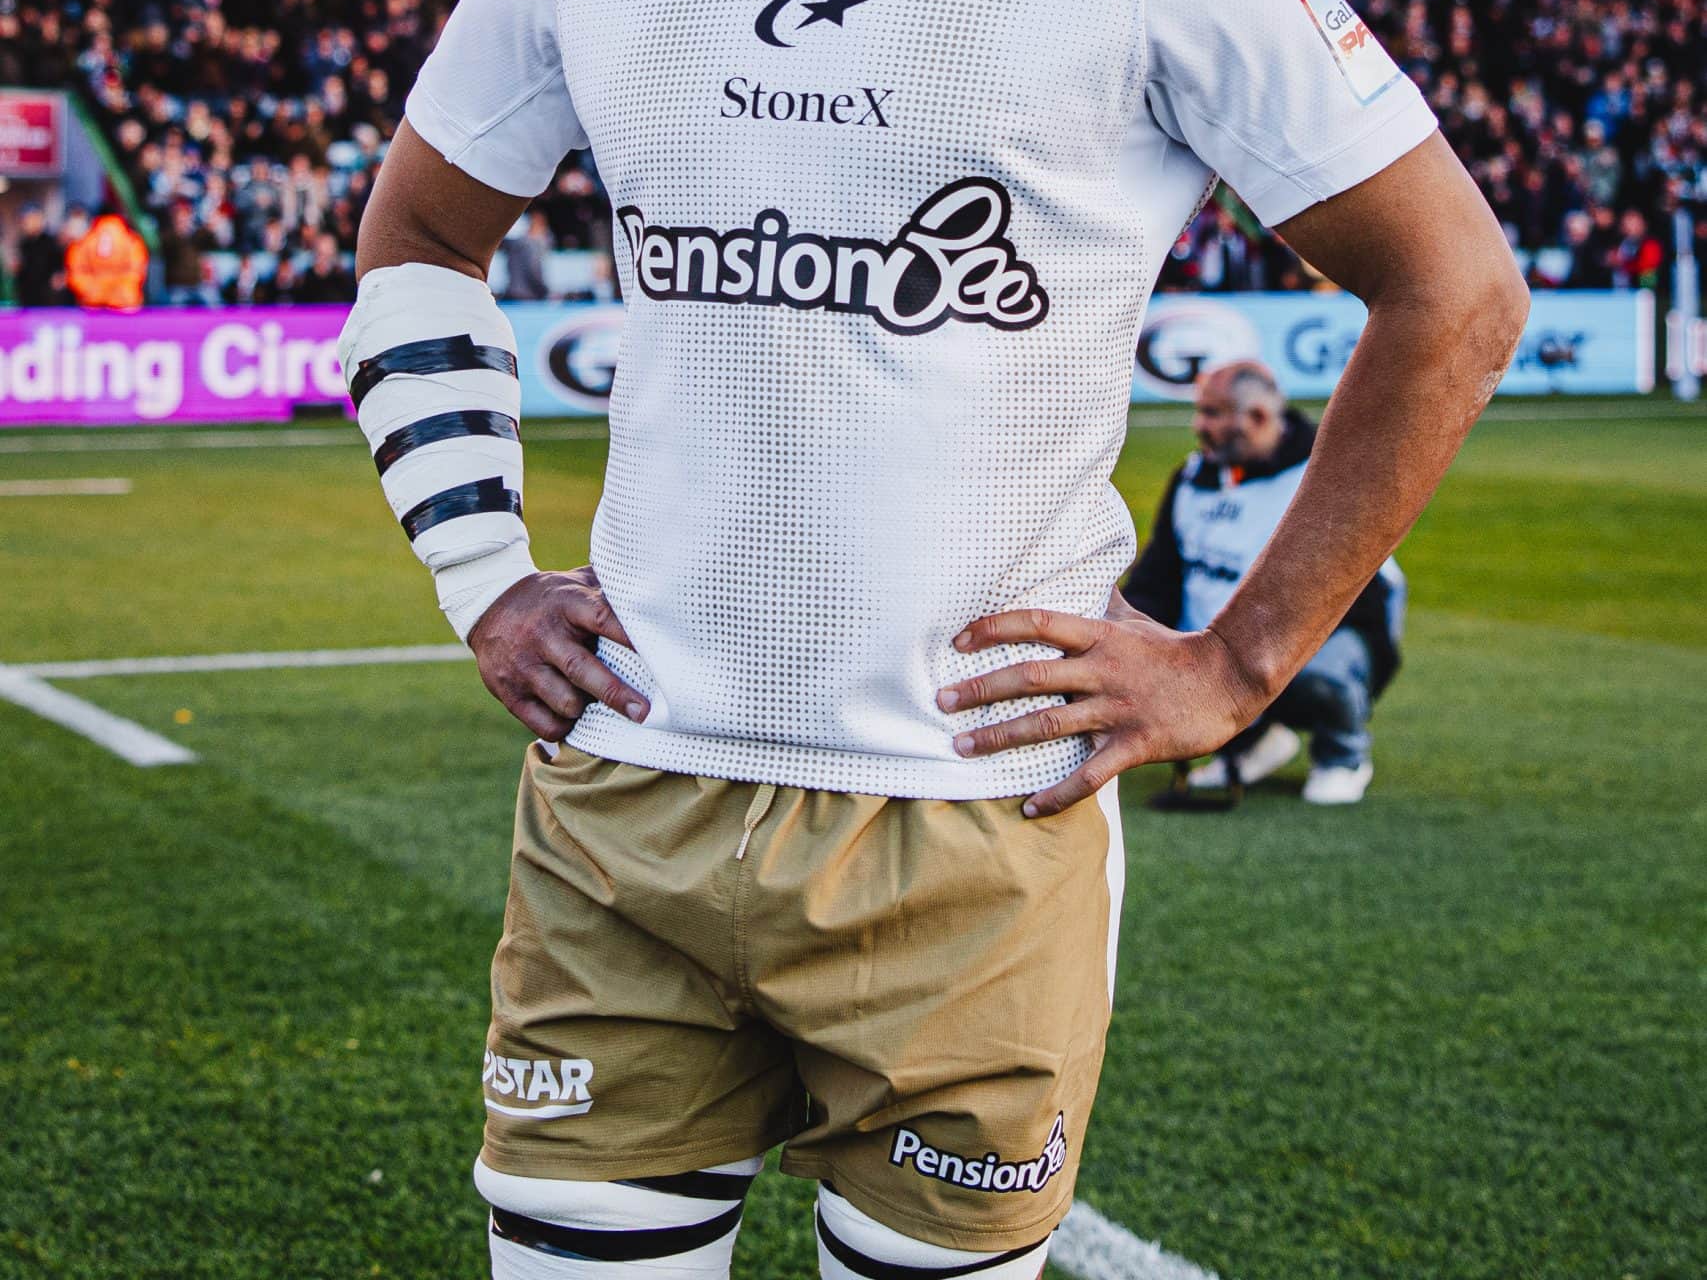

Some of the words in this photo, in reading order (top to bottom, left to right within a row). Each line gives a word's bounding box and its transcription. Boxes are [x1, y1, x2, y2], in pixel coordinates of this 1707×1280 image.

[1325, 0, 1354, 30] Gal
[720, 76, 895, 128] StoneX
[618, 177, 1048, 333] PensionBee
[0, 324, 184, 419] ding
[888, 1110, 1067, 1194] PensionBee
